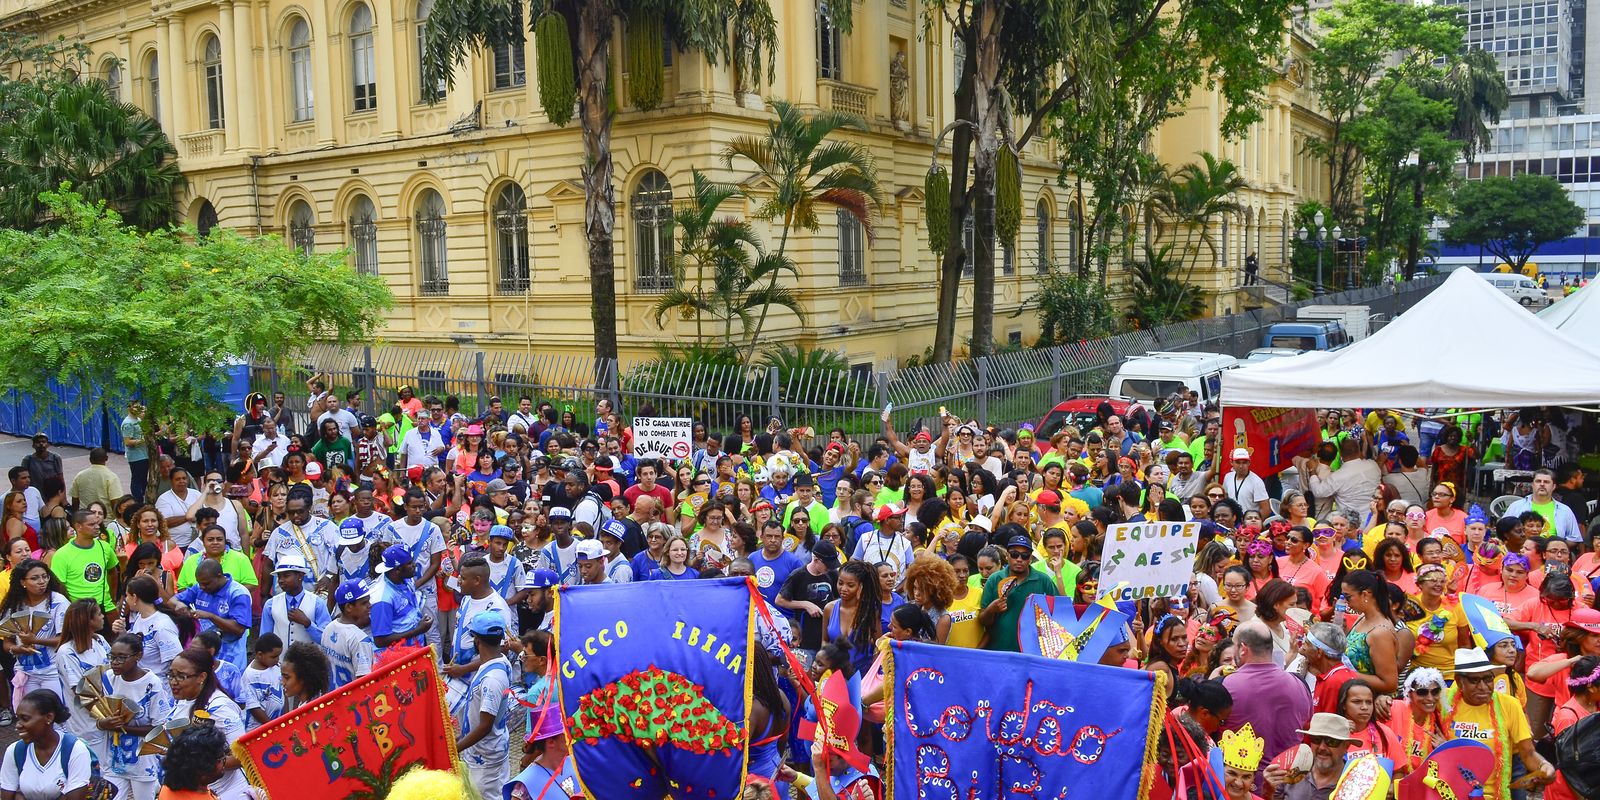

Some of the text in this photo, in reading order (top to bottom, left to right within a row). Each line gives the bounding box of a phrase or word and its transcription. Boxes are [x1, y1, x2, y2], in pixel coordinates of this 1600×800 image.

[635, 418, 650, 427] STS
[671, 420, 691, 428] VERDE
[634, 440, 672, 457] DENGUE
[1116, 523, 1195, 541] EQUIPE
[955, 612, 973, 623] Zika
[562, 621, 742, 679] CECCO IBIRA
[904, 668, 1123, 765] Cordão
[1461, 727, 1488, 739] Zika
